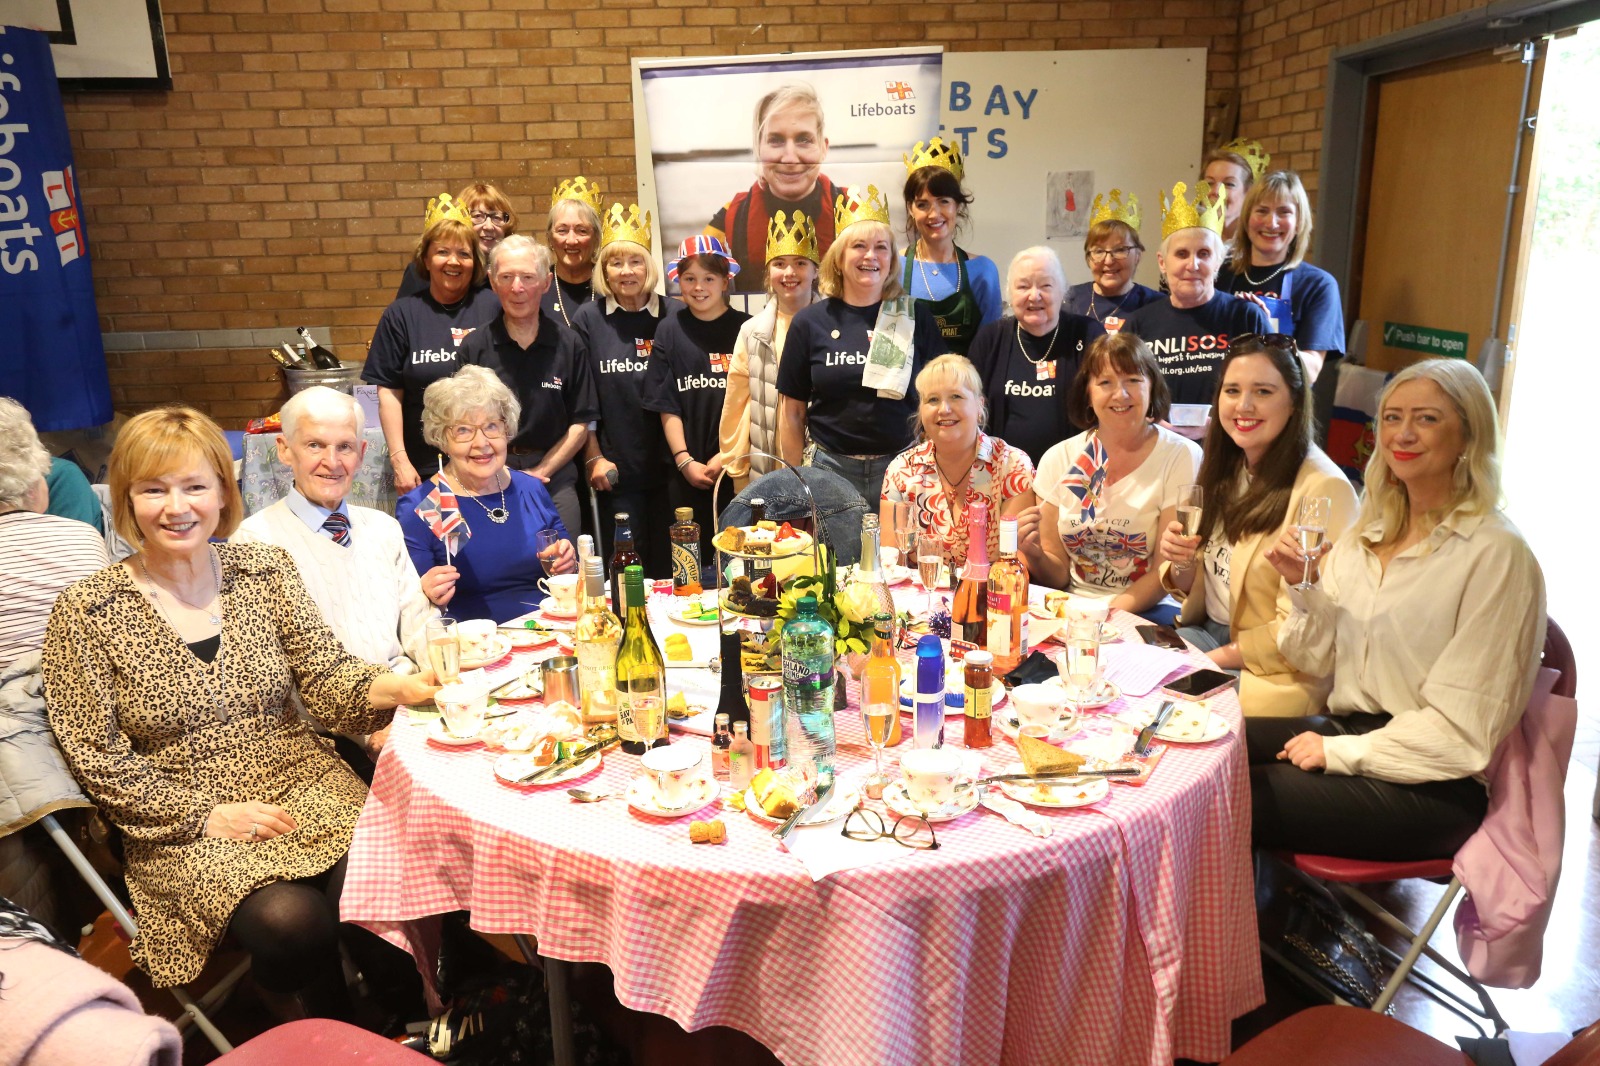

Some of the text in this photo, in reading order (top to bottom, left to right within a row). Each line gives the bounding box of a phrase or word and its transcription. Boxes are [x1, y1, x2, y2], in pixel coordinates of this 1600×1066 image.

[850, 102, 916, 117] Lifeboats
[949, 81, 1038, 120] BAY
[939, 124, 1008, 159] TS
[1396, 329, 1464, 352] Push bar to open
[412, 348, 457, 365] Lifebo
[600, 357, 649, 374] Lifeboa
[825, 351, 867, 366] Lifeb
[677, 373, 727, 392] Lifeboa
[1111, 518, 1130, 527] CUP
[682, 555, 698, 582] SYRUP
